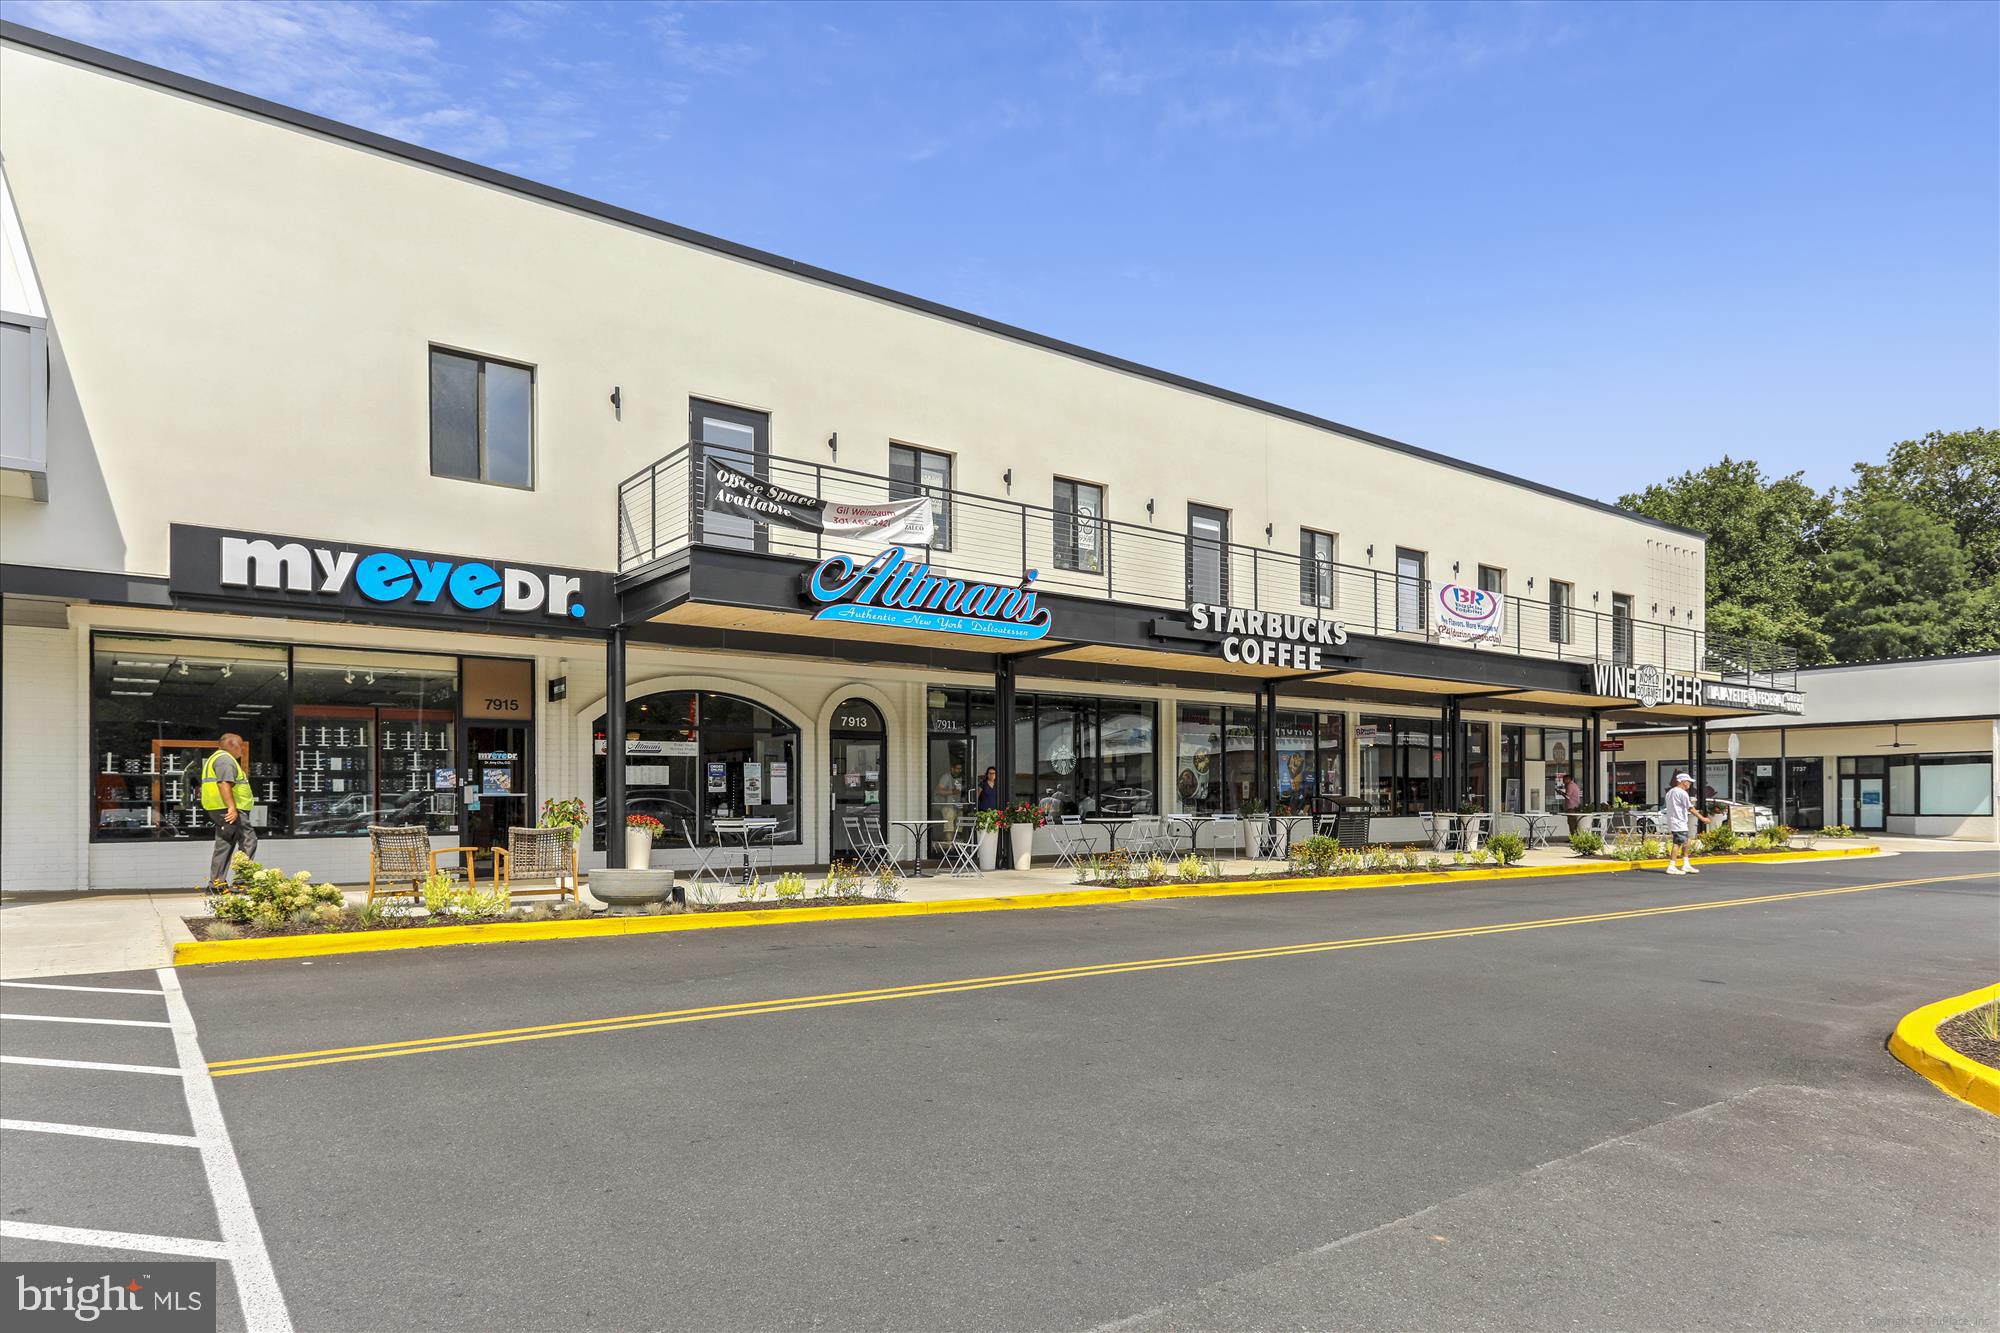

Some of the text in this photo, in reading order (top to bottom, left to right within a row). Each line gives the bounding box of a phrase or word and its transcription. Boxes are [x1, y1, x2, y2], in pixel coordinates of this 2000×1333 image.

[716, 469, 817, 508] Office Space
[836, 506, 849, 515] Gil
[851, 507, 897, 517] Weinbaum
[1453, 587, 1485, 606] BR
[838, 607, 1029, 636] Authentic New York Delicatessen
[1192, 603, 1348, 646] STARBUCKS
[1223, 636, 1322, 671] COFFEE
[1594, 663, 1636, 699] WINE
[1664, 672, 1703, 706] BEER
[484, 698, 520, 711] 7915
[841, 716, 867, 728] 7913
[937, 719, 957, 730] 7911
